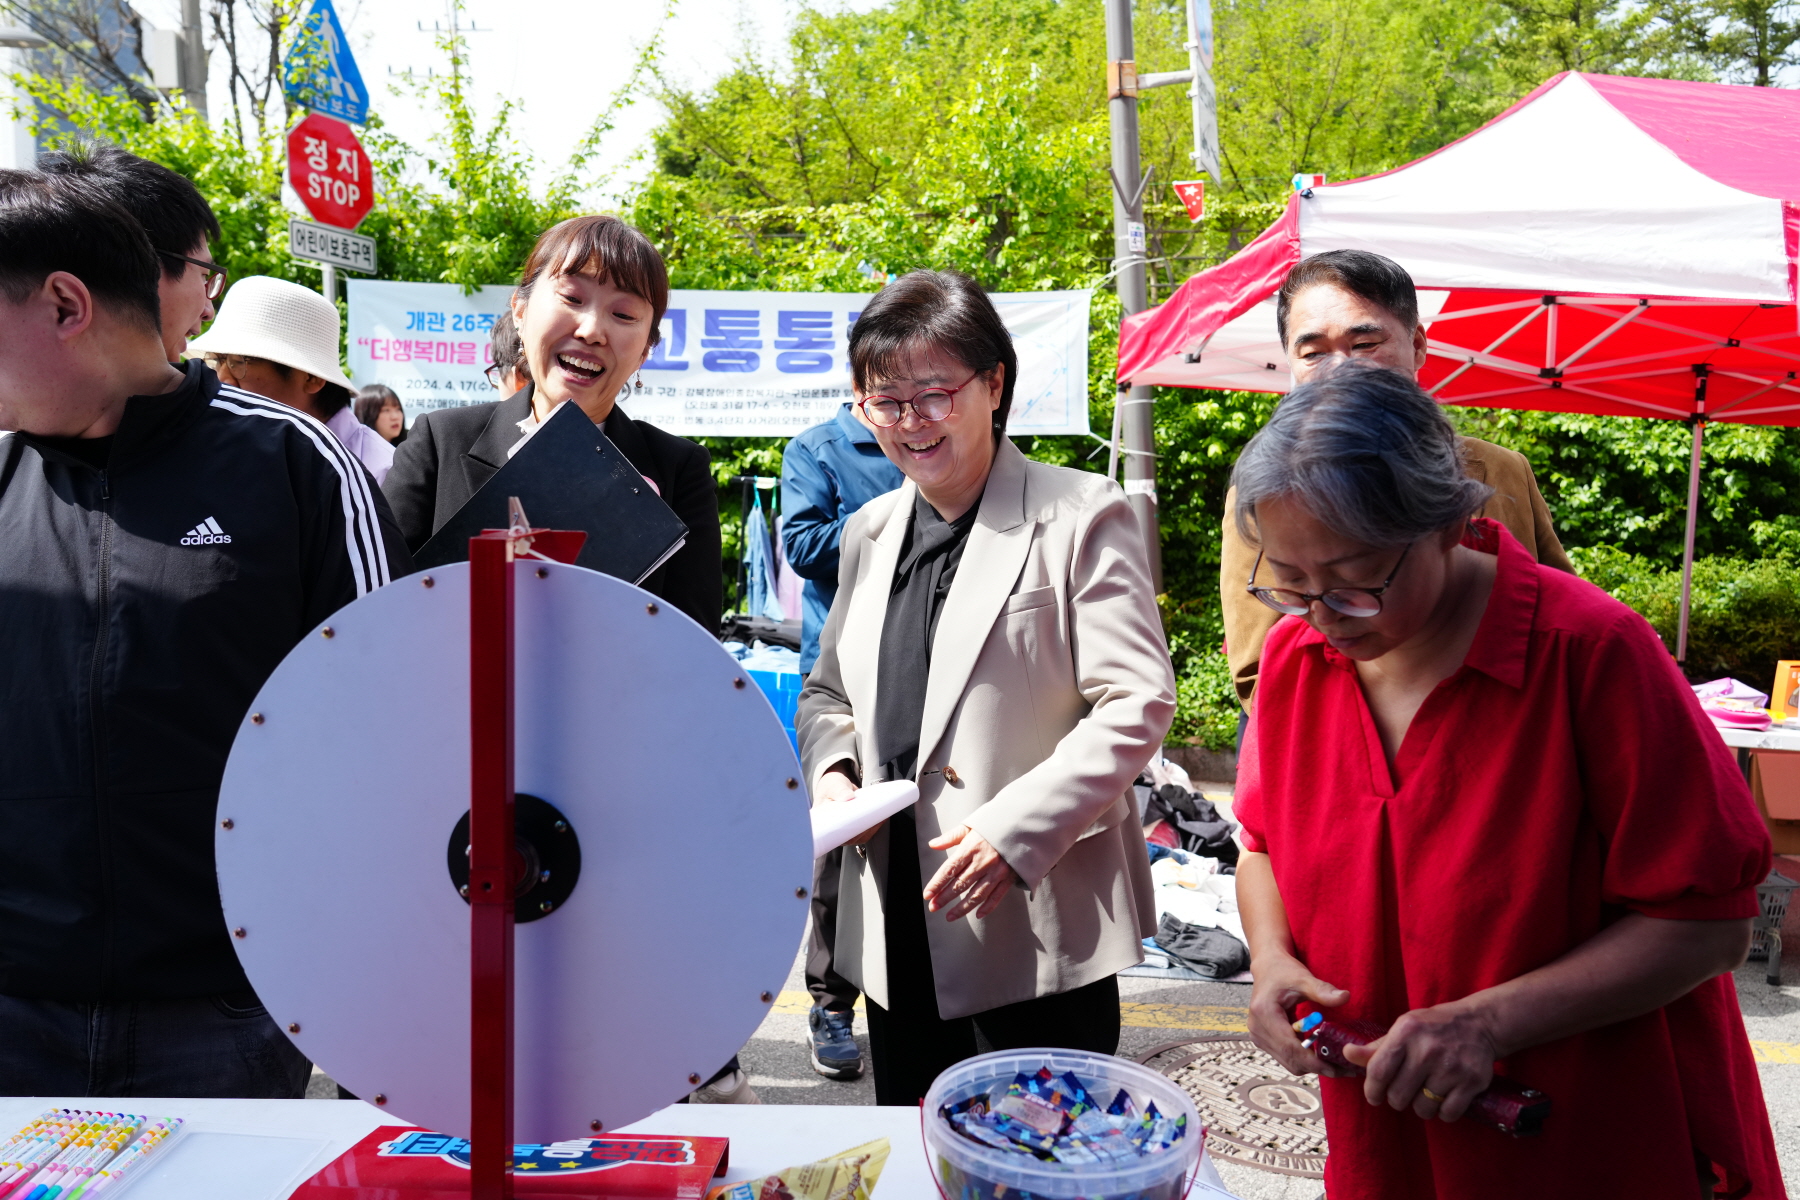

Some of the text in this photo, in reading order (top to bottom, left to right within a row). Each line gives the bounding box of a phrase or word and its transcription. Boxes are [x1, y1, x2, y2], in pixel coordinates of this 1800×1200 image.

[308, 172, 361, 208] STOP
[296, 227, 372, 267] 어린이보호구역
[406, 311, 502, 334] 개관 26주
[656, 386, 677, 397] 구간
[180, 534, 232, 546] adidas
